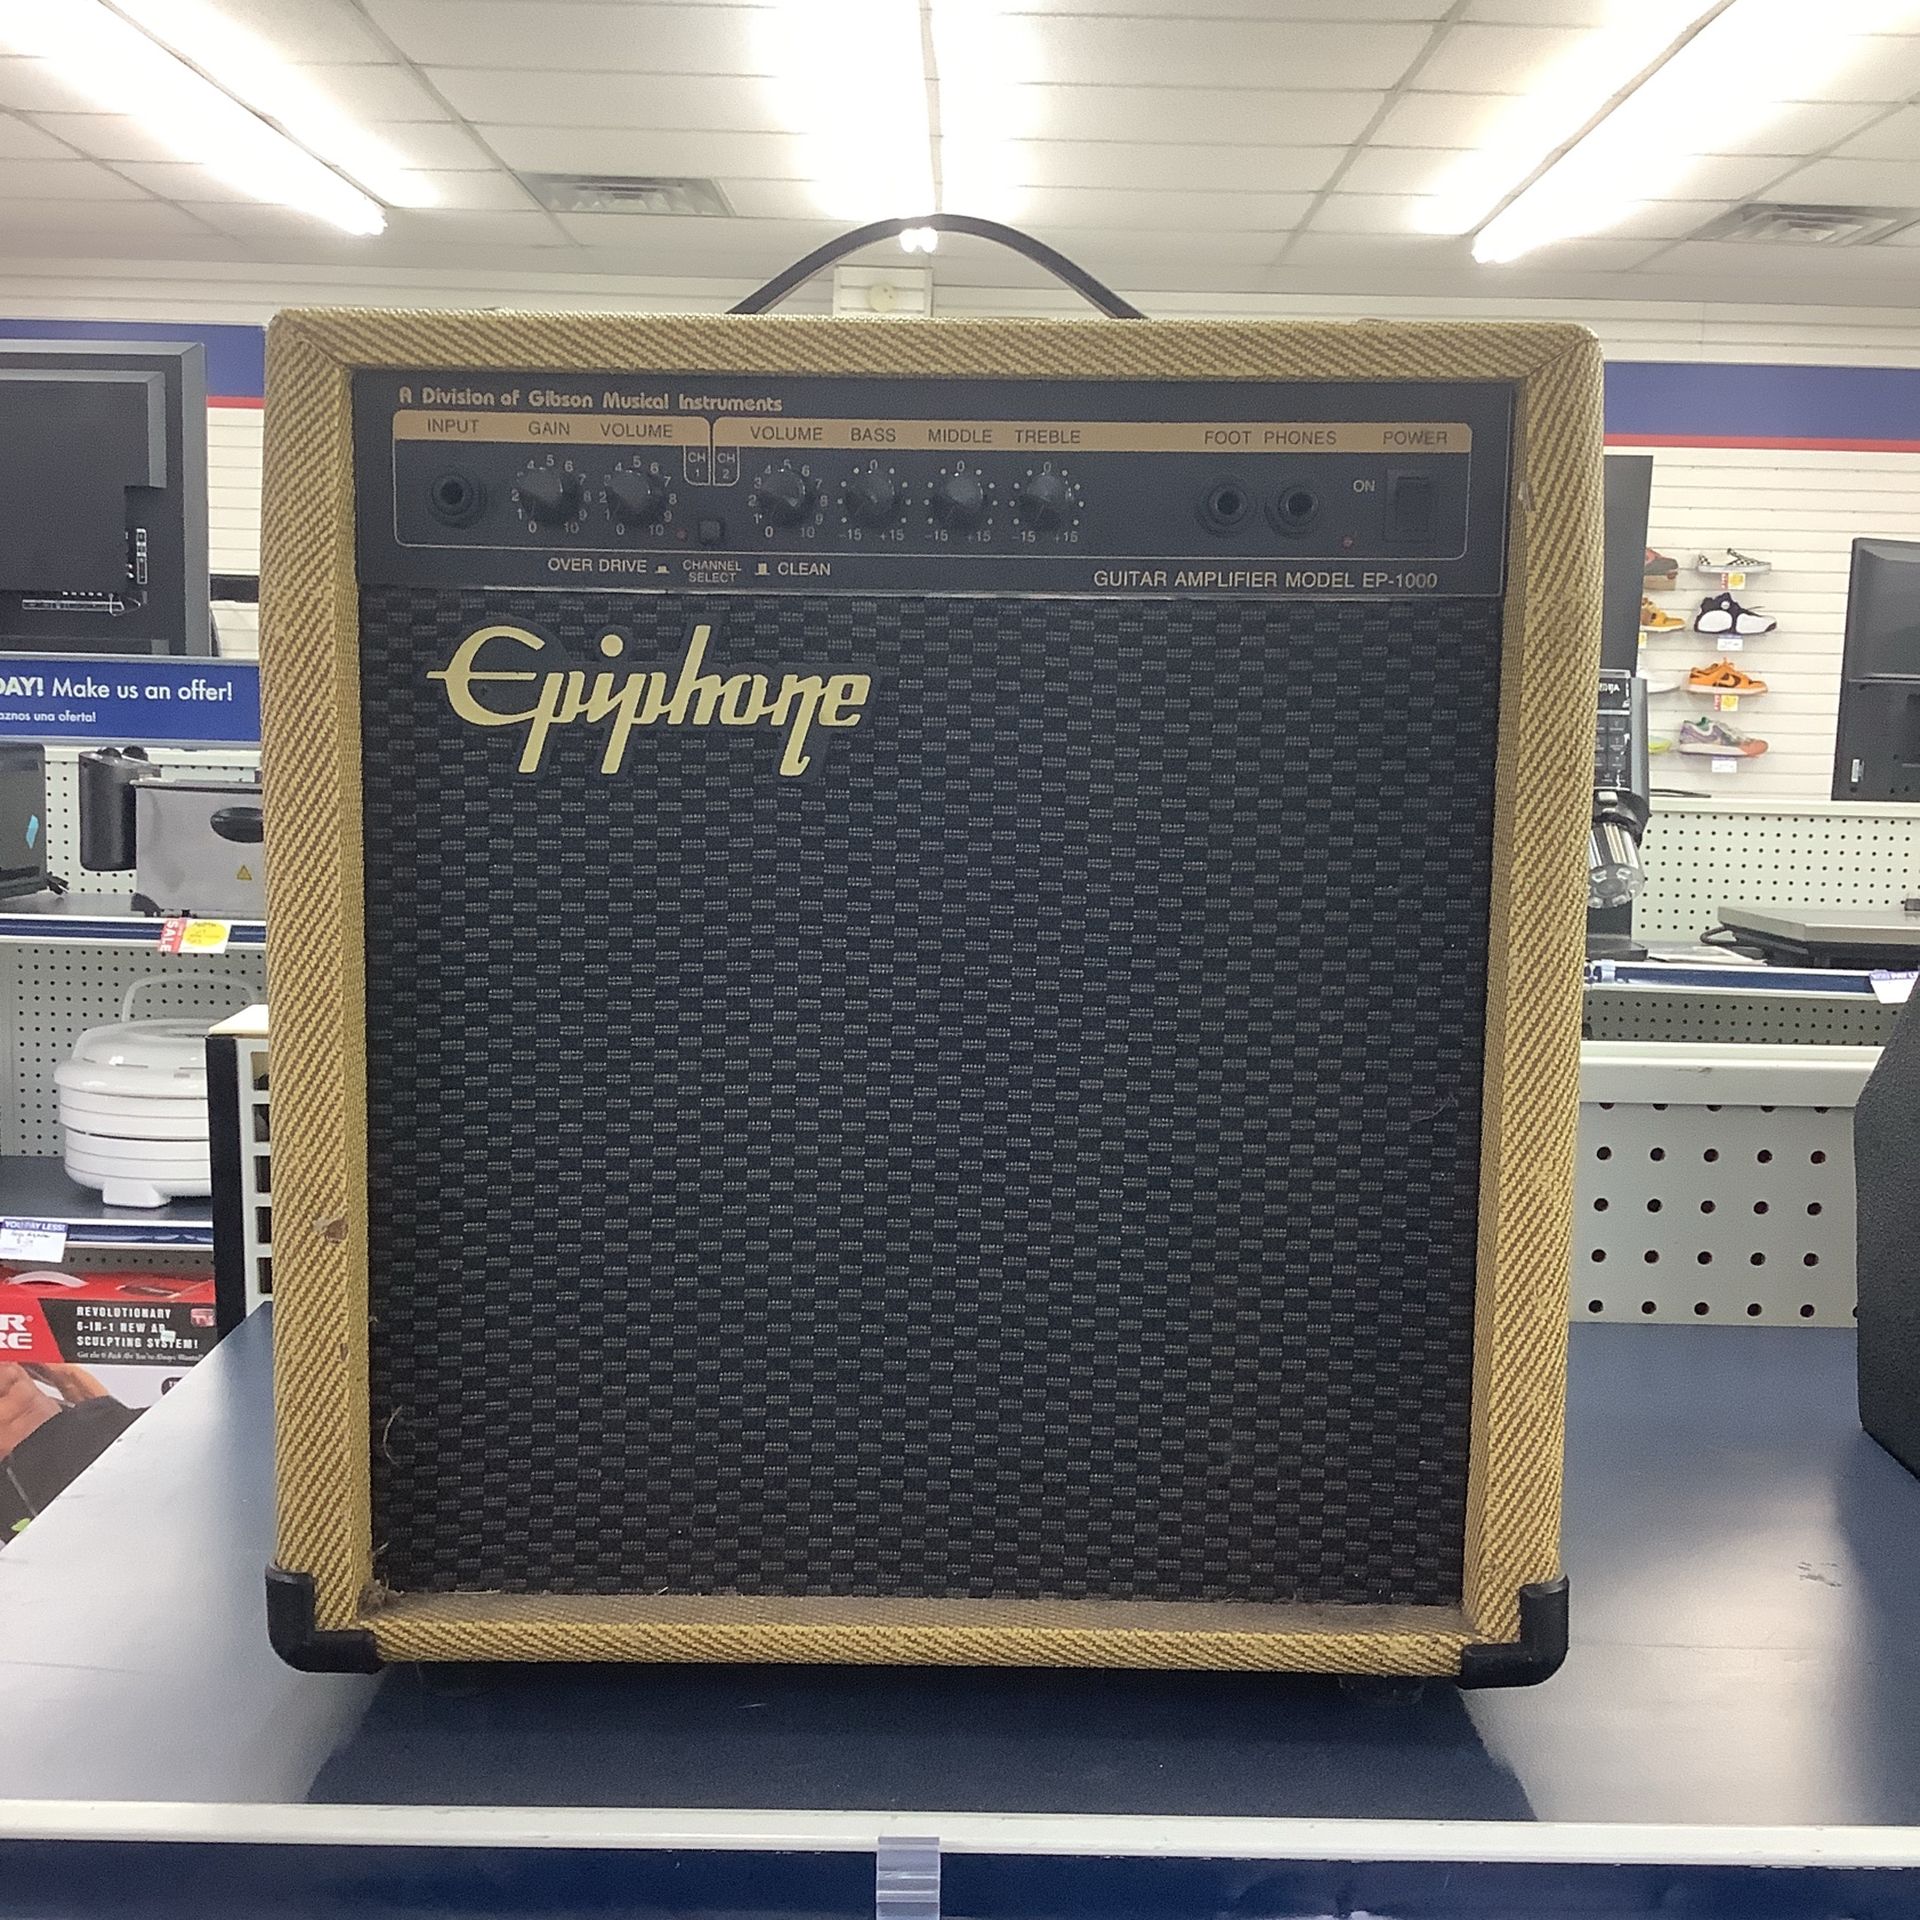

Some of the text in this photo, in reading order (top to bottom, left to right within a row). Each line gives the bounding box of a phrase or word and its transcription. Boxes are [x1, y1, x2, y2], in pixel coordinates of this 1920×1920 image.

[399, 386, 783, 412] A Division of Gibson Musical Instruments
[427, 419, 479, 434] INPUT
[528, 421, 570, 436] GAIN
[599, 423, 673, 438] VOLUME
[750, 426, 823, 441] VOLUME
[851, 427, 896, 443] BASS
[928, 429, 993, 444] MIDDLE
[1015, 430, 1081, 445] TREBLE
[1204, 430, 1252, 445] FOOT
[1263, 431, 1337, 445] PHONES
[1382, 431, 1448, 445] POWER
[688, 452, 706, 463] CH
[717, 453, 736, 464] CH
[722, 469, 730, 479] 2
[1353, 480, 1375, 493] ON
[548, 558, 647, 573] OVER DRIVE
[682, 560, 742, 571] CHANNEL
[777, 562, 831, 577] CLEAN
[688, 572, 737, 583] SELECT
[1094, 570, 1438, 589] GUITAR AMPLIFIER MODEL EP-1000
[52, 676, 110, 698] Make
[117, 684, 139, 699] us
[145, 684, 171, 700] an
[177, 679, 233, 701] offer!
[426, 624, 872, 777] Epiphone
[34, 713, 55, 722] una
[58, 709, 97, 723] oferta!
[158, 920, 178, 952] SALE
[76, 1306, 172, 1319] REVOLUTIONARY
[120, 1323, 146, 1333] NEW
[76, 1336, 198, 1349] SCULPTING SYSTEM!
